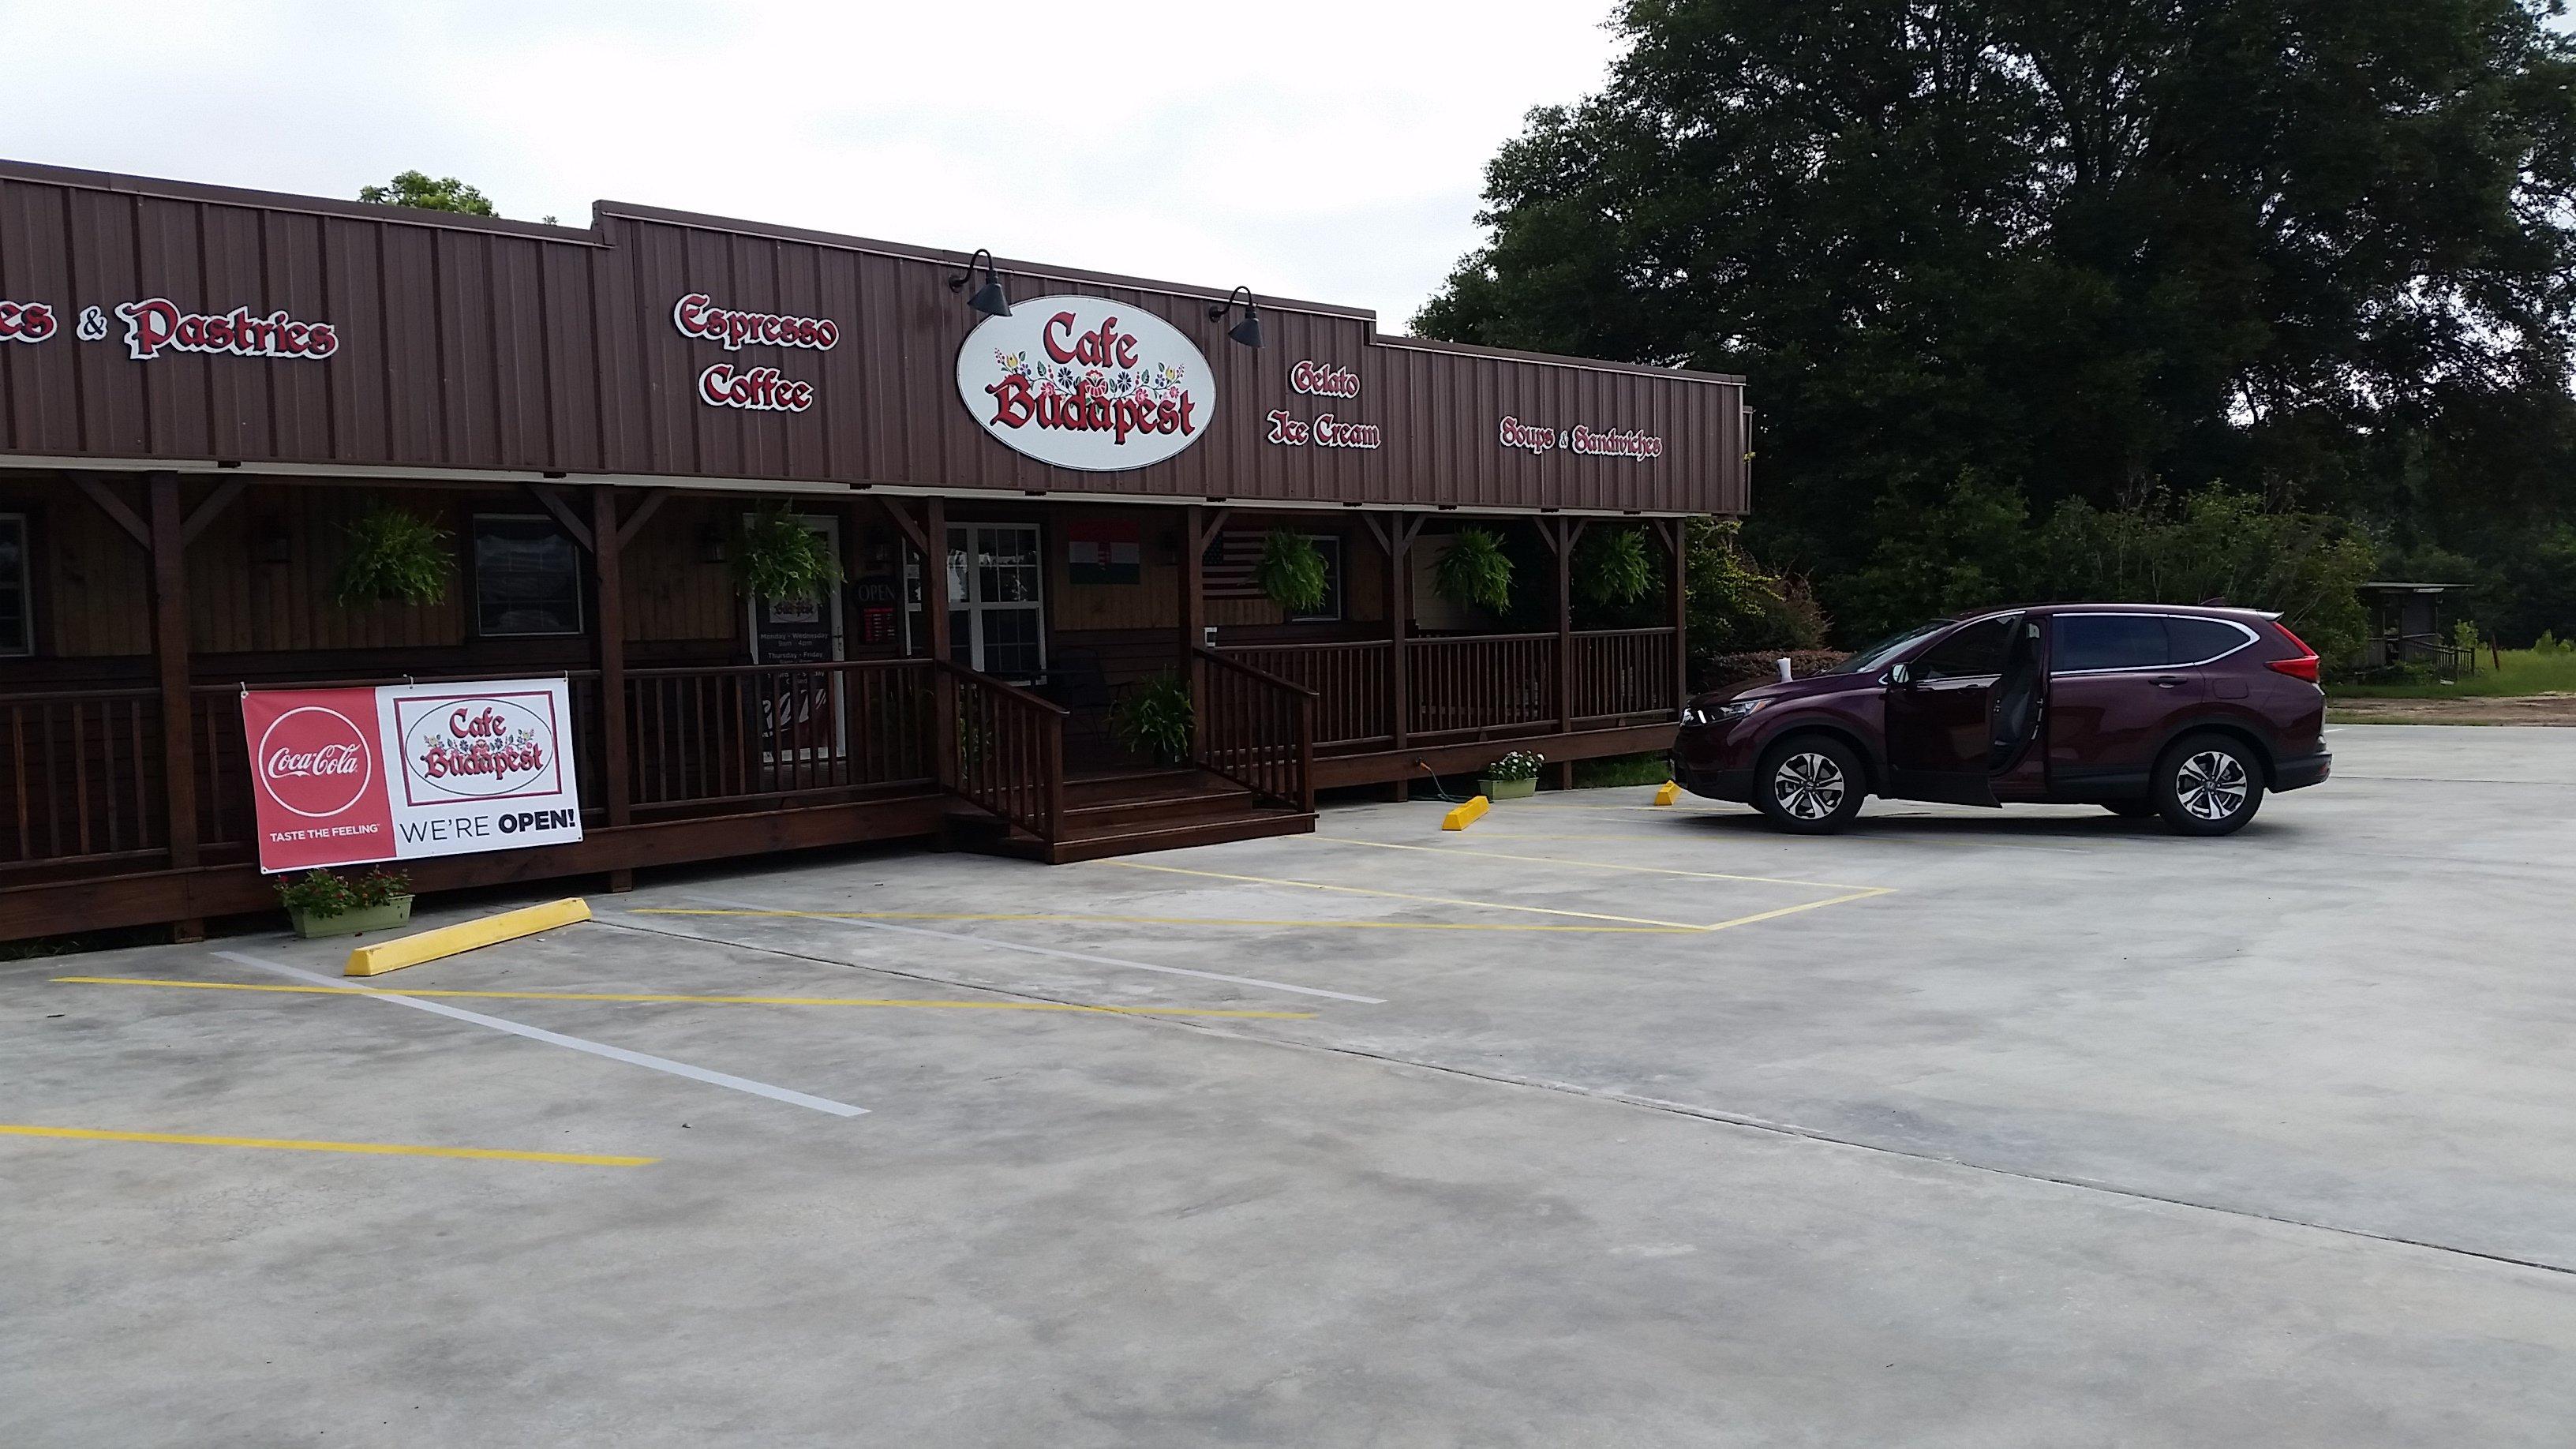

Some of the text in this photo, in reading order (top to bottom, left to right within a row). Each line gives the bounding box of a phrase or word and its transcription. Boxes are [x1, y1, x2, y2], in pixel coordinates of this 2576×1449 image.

[78, 305, 107, 339] &
[115, 298, 339, 359] Pastries
[675, 294, 838, 350] Espresso
[1043, 312, 1139, 369] Cafe
[699, 364, 814, 412] Coffee
[1291, 361, 1360, 398] Gelato
[985, 375, 1196, 445] Budapest
[1267, 410, 1380, 449] Ice Cream
[1500, 417, 1662, 461] Soups & Sandwiches
[858, 584, 896, 601] OPEN
[449, 706, 507, 739] Cafe
[268, 743, 361, 779] Coca-Cola
[420, 743, 544, 781] Budapest
[270, 824, 379, 843] TASTE THE FEELING
[399, 808, 576, 844] WE'RE OPEN!
